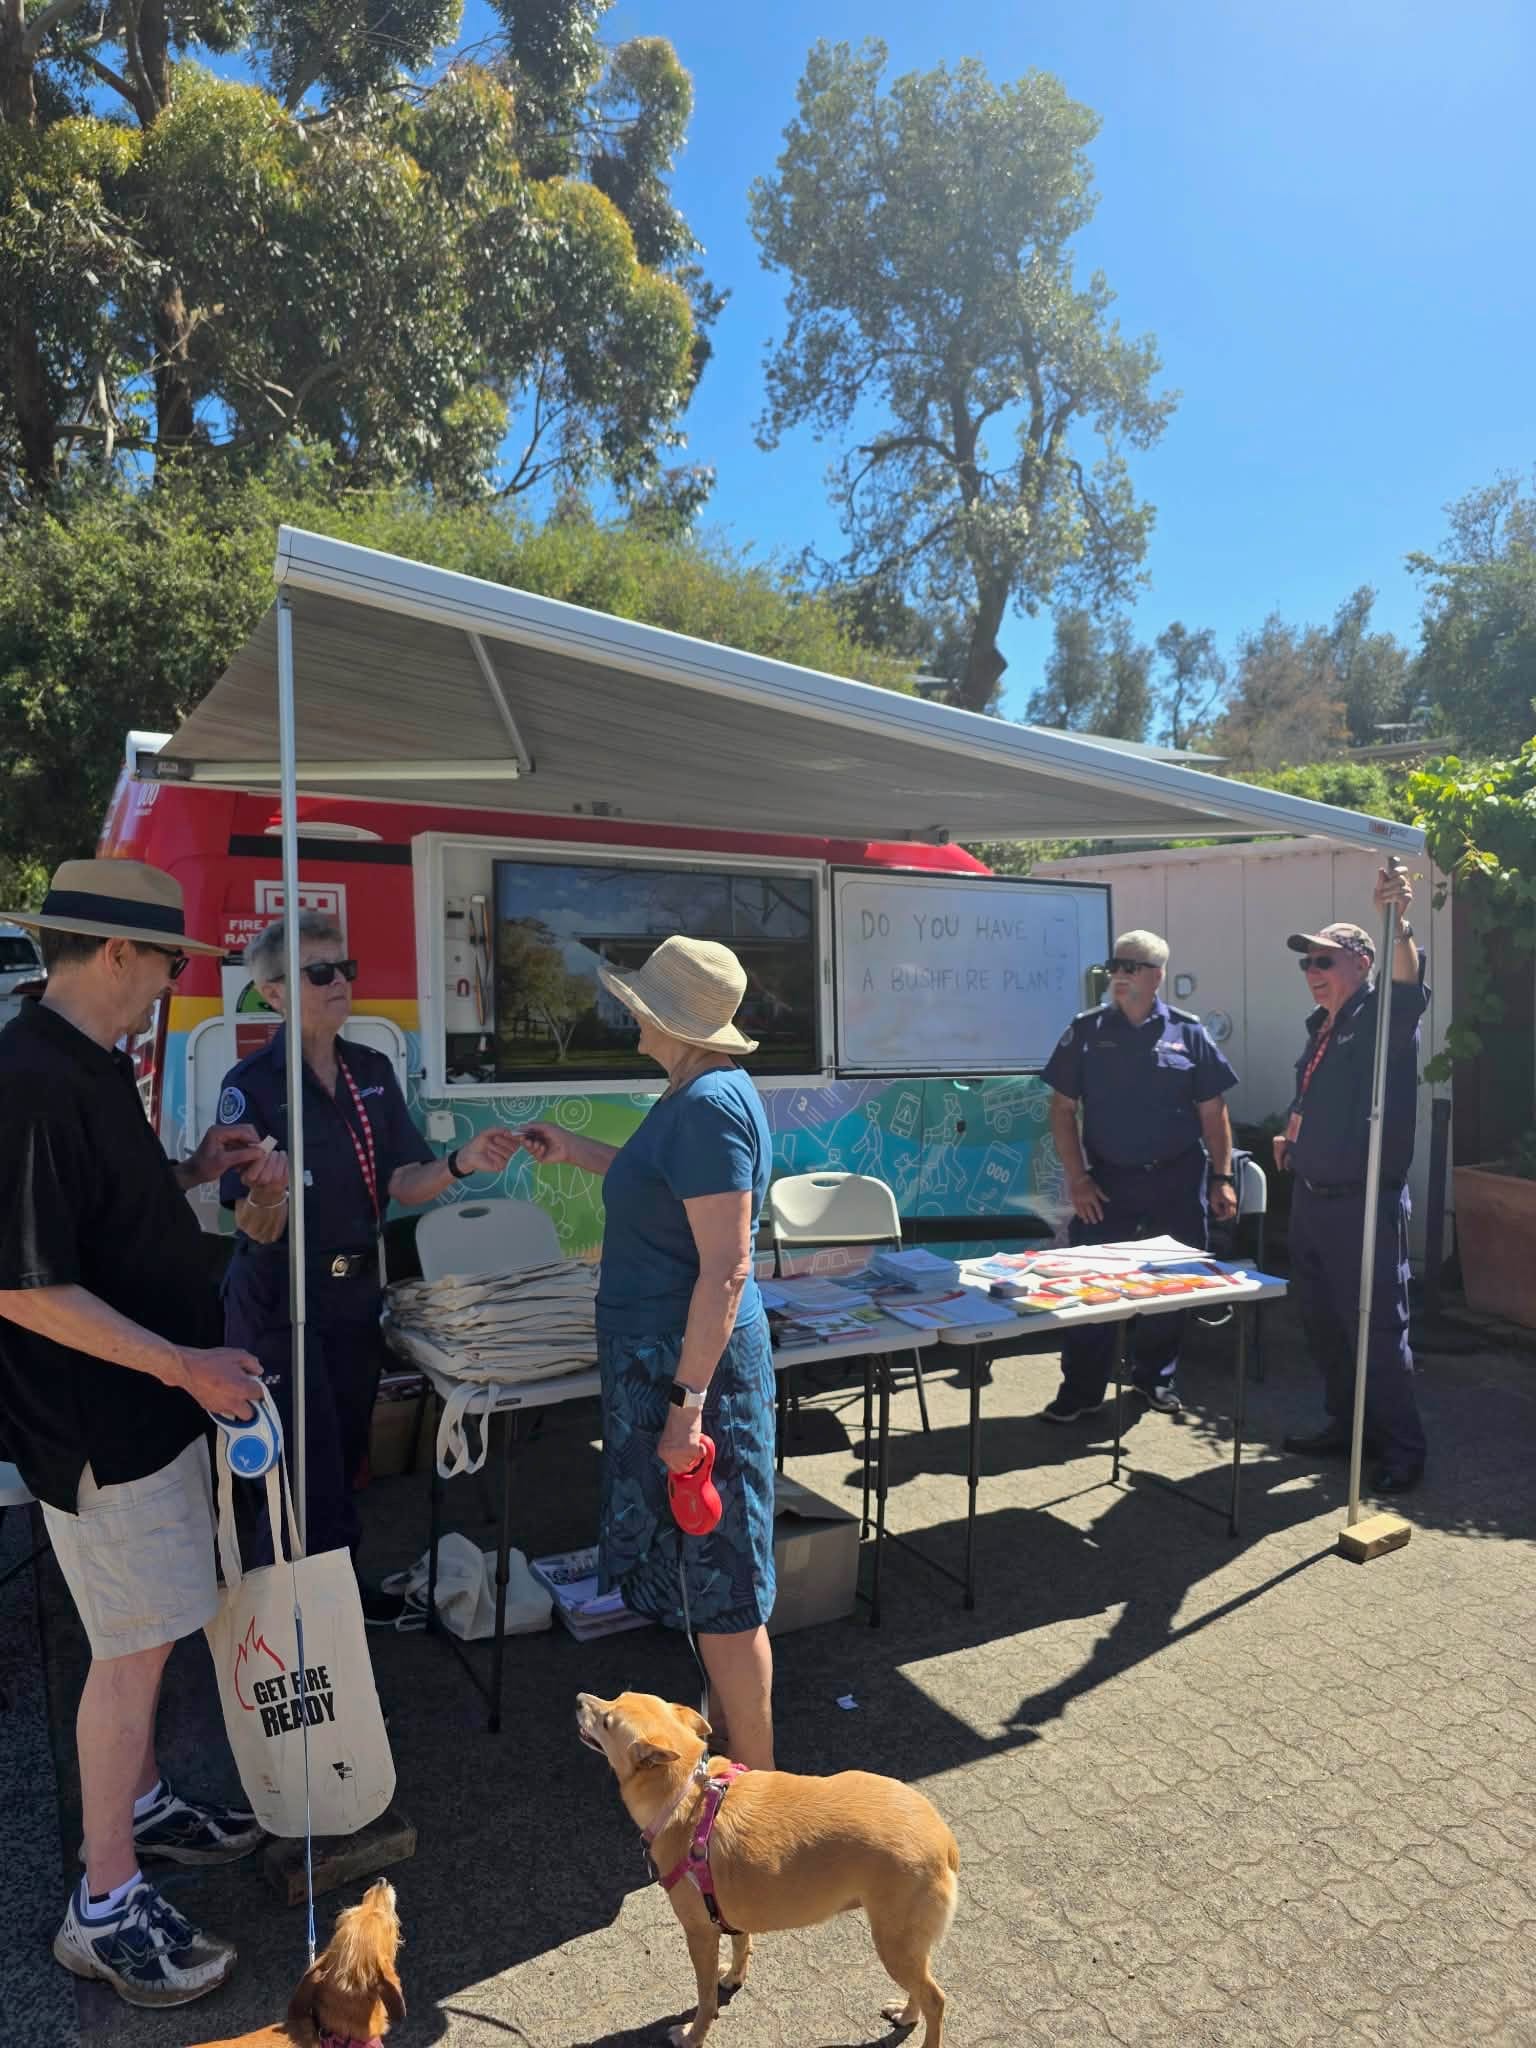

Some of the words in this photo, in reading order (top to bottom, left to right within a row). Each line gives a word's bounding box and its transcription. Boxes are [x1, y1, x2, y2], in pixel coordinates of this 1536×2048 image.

[229, 919, 264, 931] FIRE
[861, 909, 890, 940] DO
[913, 913, 960, 942] YOU
[976, 916, 1028, 941] HAVE
[224, 933, 256, 945] RAT
[863, 967, 875, 992] A
[890, 967, 992, 993] BUSHFIRE
[986, 1161, 1010, 1183] 000
[253, 1674, 288, 1705] GET
[260, 1691, 335, 1738] READY
